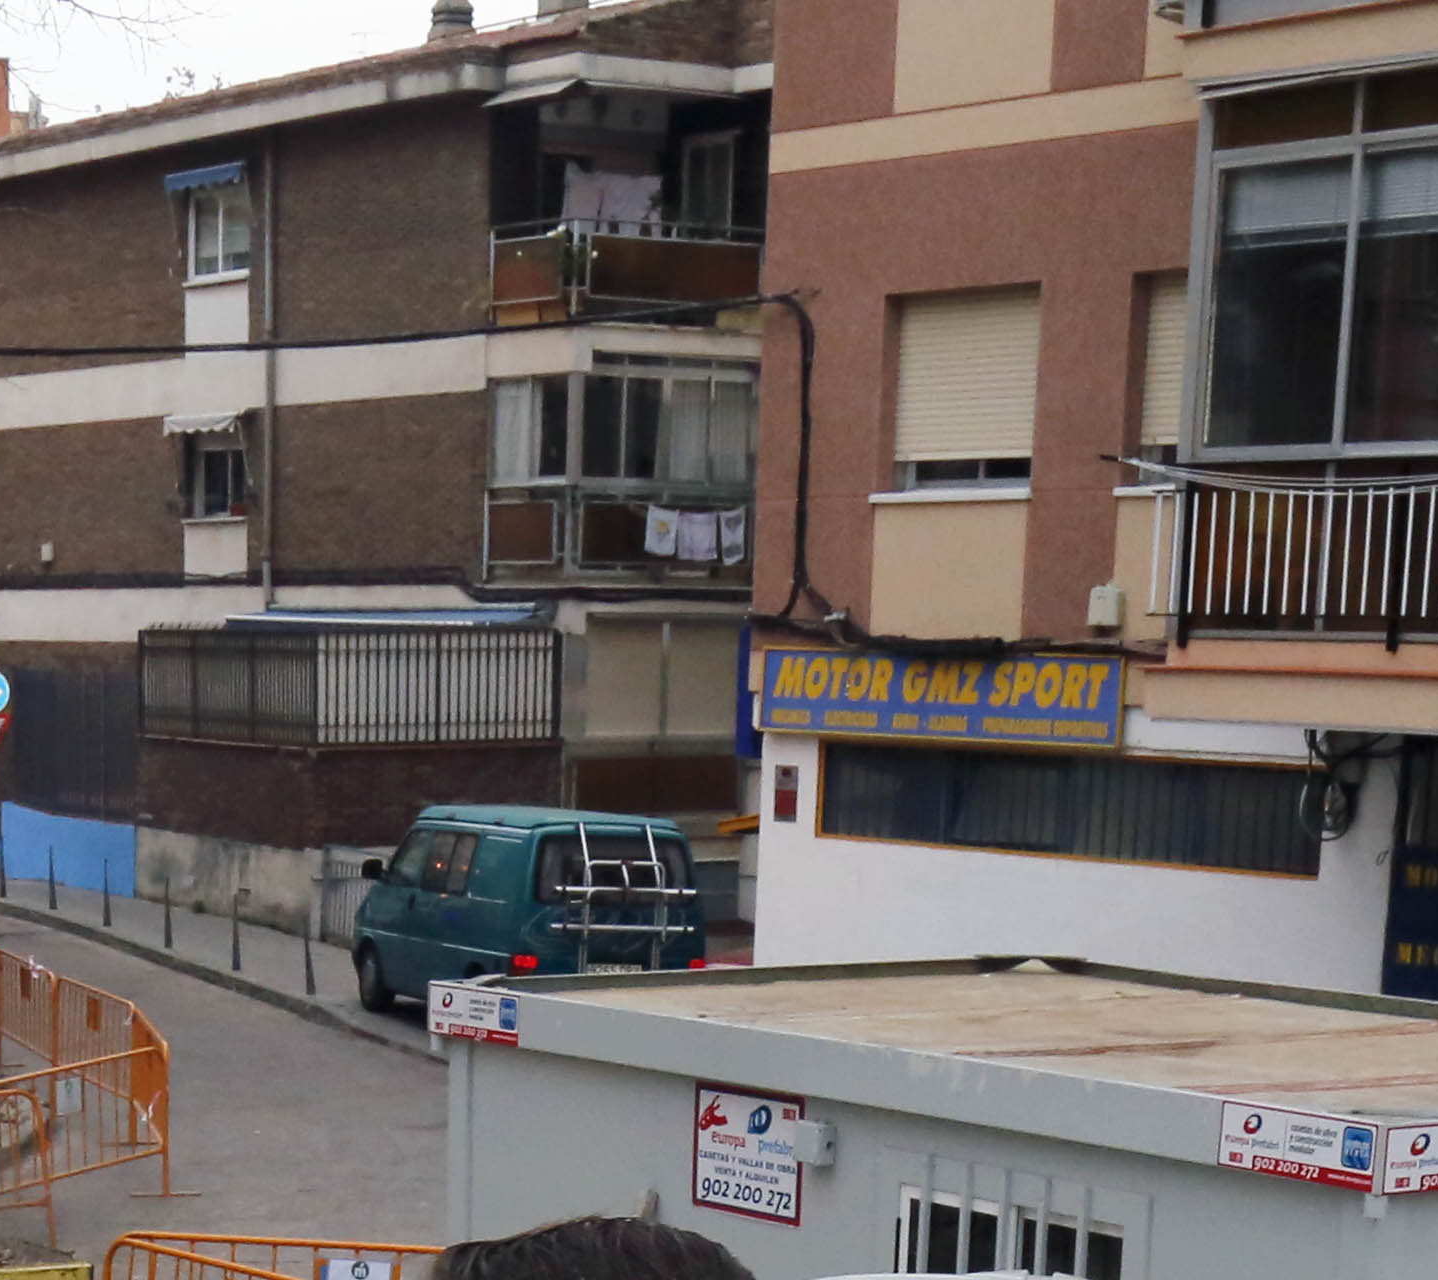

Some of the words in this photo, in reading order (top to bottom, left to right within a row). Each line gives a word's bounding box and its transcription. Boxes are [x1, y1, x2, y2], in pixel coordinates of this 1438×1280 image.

[773, 657, 893, 703] MOTOR
[903, 660, 984, 705] GMZ
[989, 661, 1110, 710] SPORT
[712, 1131, 746, 1151] europa
[699, 1149, 730, 1163] CASETAS
[731, 1155, 736, 1163] Y
[738, 1156, 765, 1169] VALLAS
[765, 1162, 775, 1170] DE
[777, 1164, 797, 1175] OBRA
[1253, 1157, 1275, 1170] 902
[1277, 1161, 1300, 1174] 200
[1300, 1165, 1320, 1180] 272
[715, 1166, 736, 1177] VENTA
[739, 1170, 743, 1178] Y
[744, 1171, 780, 1185] ALQUILER
[702, 1177, 730, 1199] 902
[733, 1183, 763, 1204] 200
[766, 1189, 793, 1214] 272
